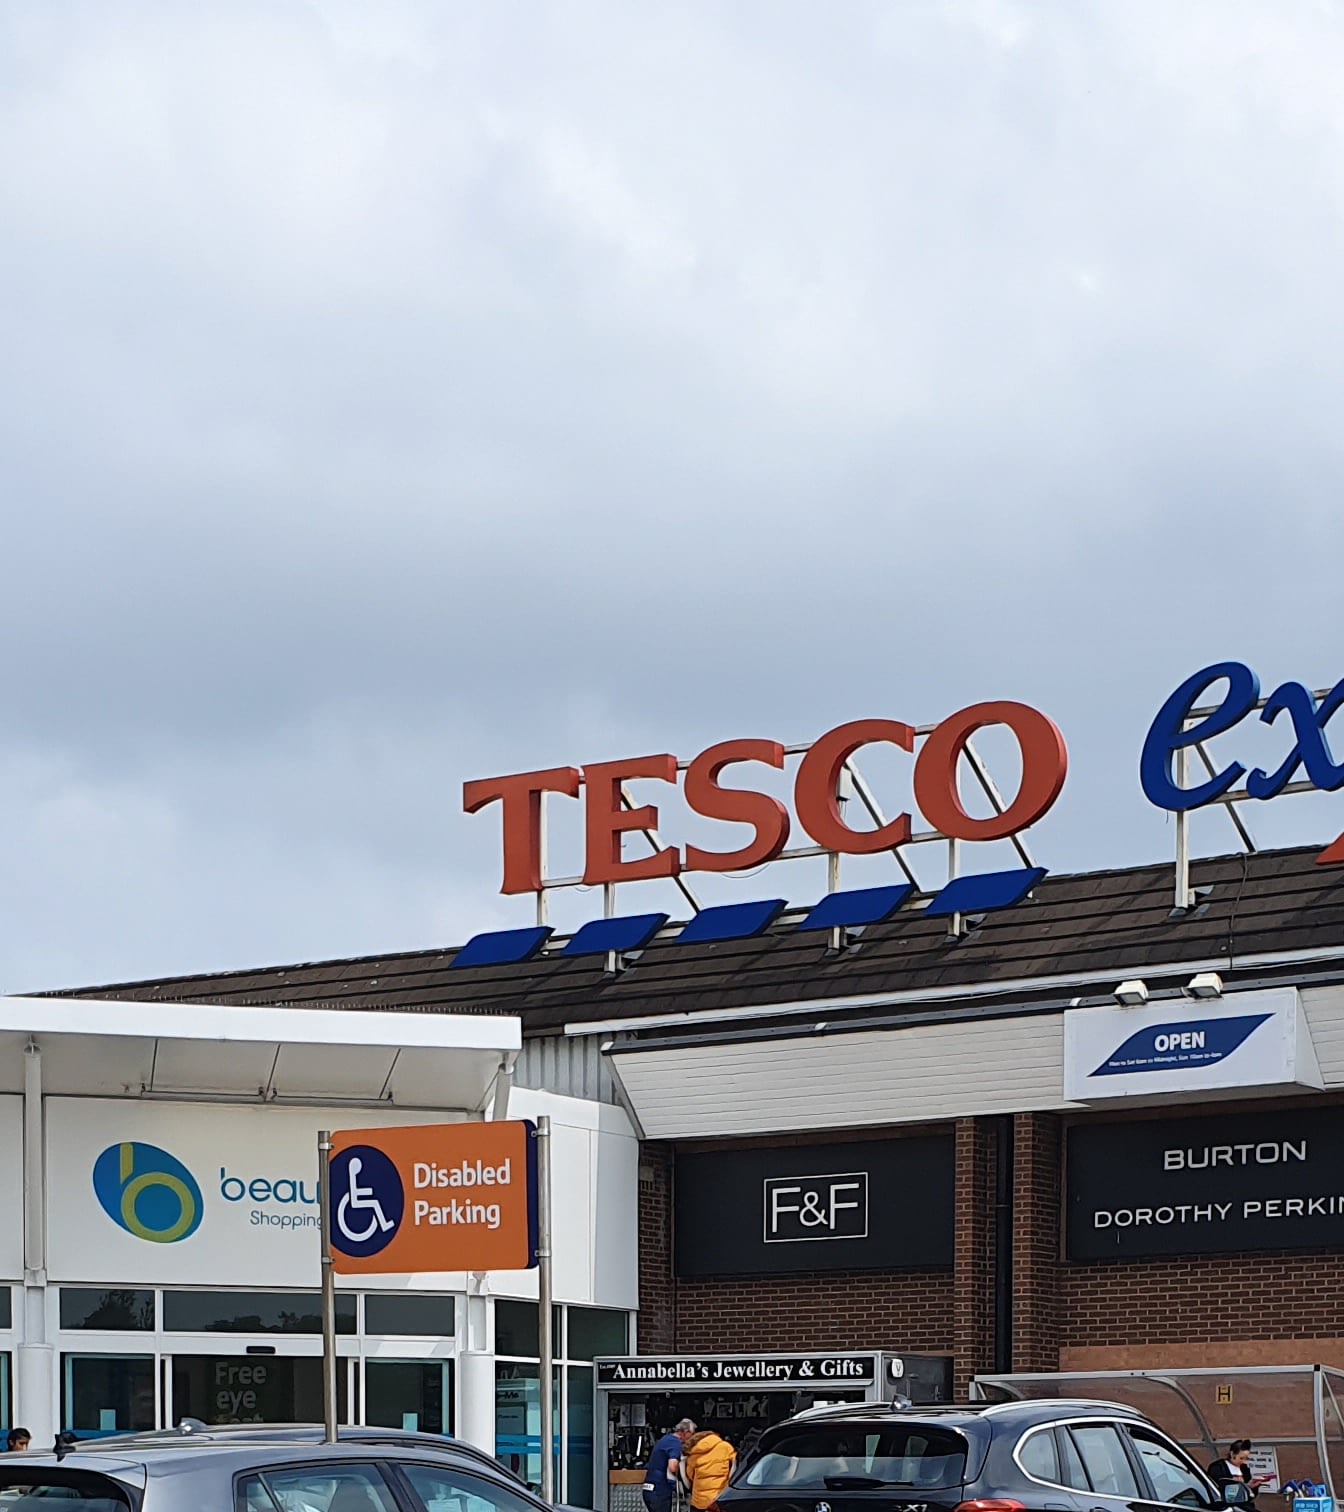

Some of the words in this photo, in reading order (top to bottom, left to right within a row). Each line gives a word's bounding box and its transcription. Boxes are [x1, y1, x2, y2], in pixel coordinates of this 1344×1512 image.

[463, 699, 1068, 896] TESCO
[1155, 1031, 1205, 1052] OPEN
[1164, 1140, 1307, 1171] BURTON
[220, 1167, 321, 1204] beau
[413, 1158, 511, 1189] Disabled
[414, 1199, 501, 1230] Parking
[771, 1183, 860, 1232] F&F
[1094, 1201, 1232, 1228] DOROTHY
[216, 1361, 266, 1385] Free
[613, 1363, 708, 1379] Annabella's
[713, 1361, 794, 1381] Jewellery
[799, 1360, 814, 1377] &
[821, 1359, 864, 1377] Gifts
[216, 1390, 256, 1415] eye
[902, 1504, 928, 1512] X1
